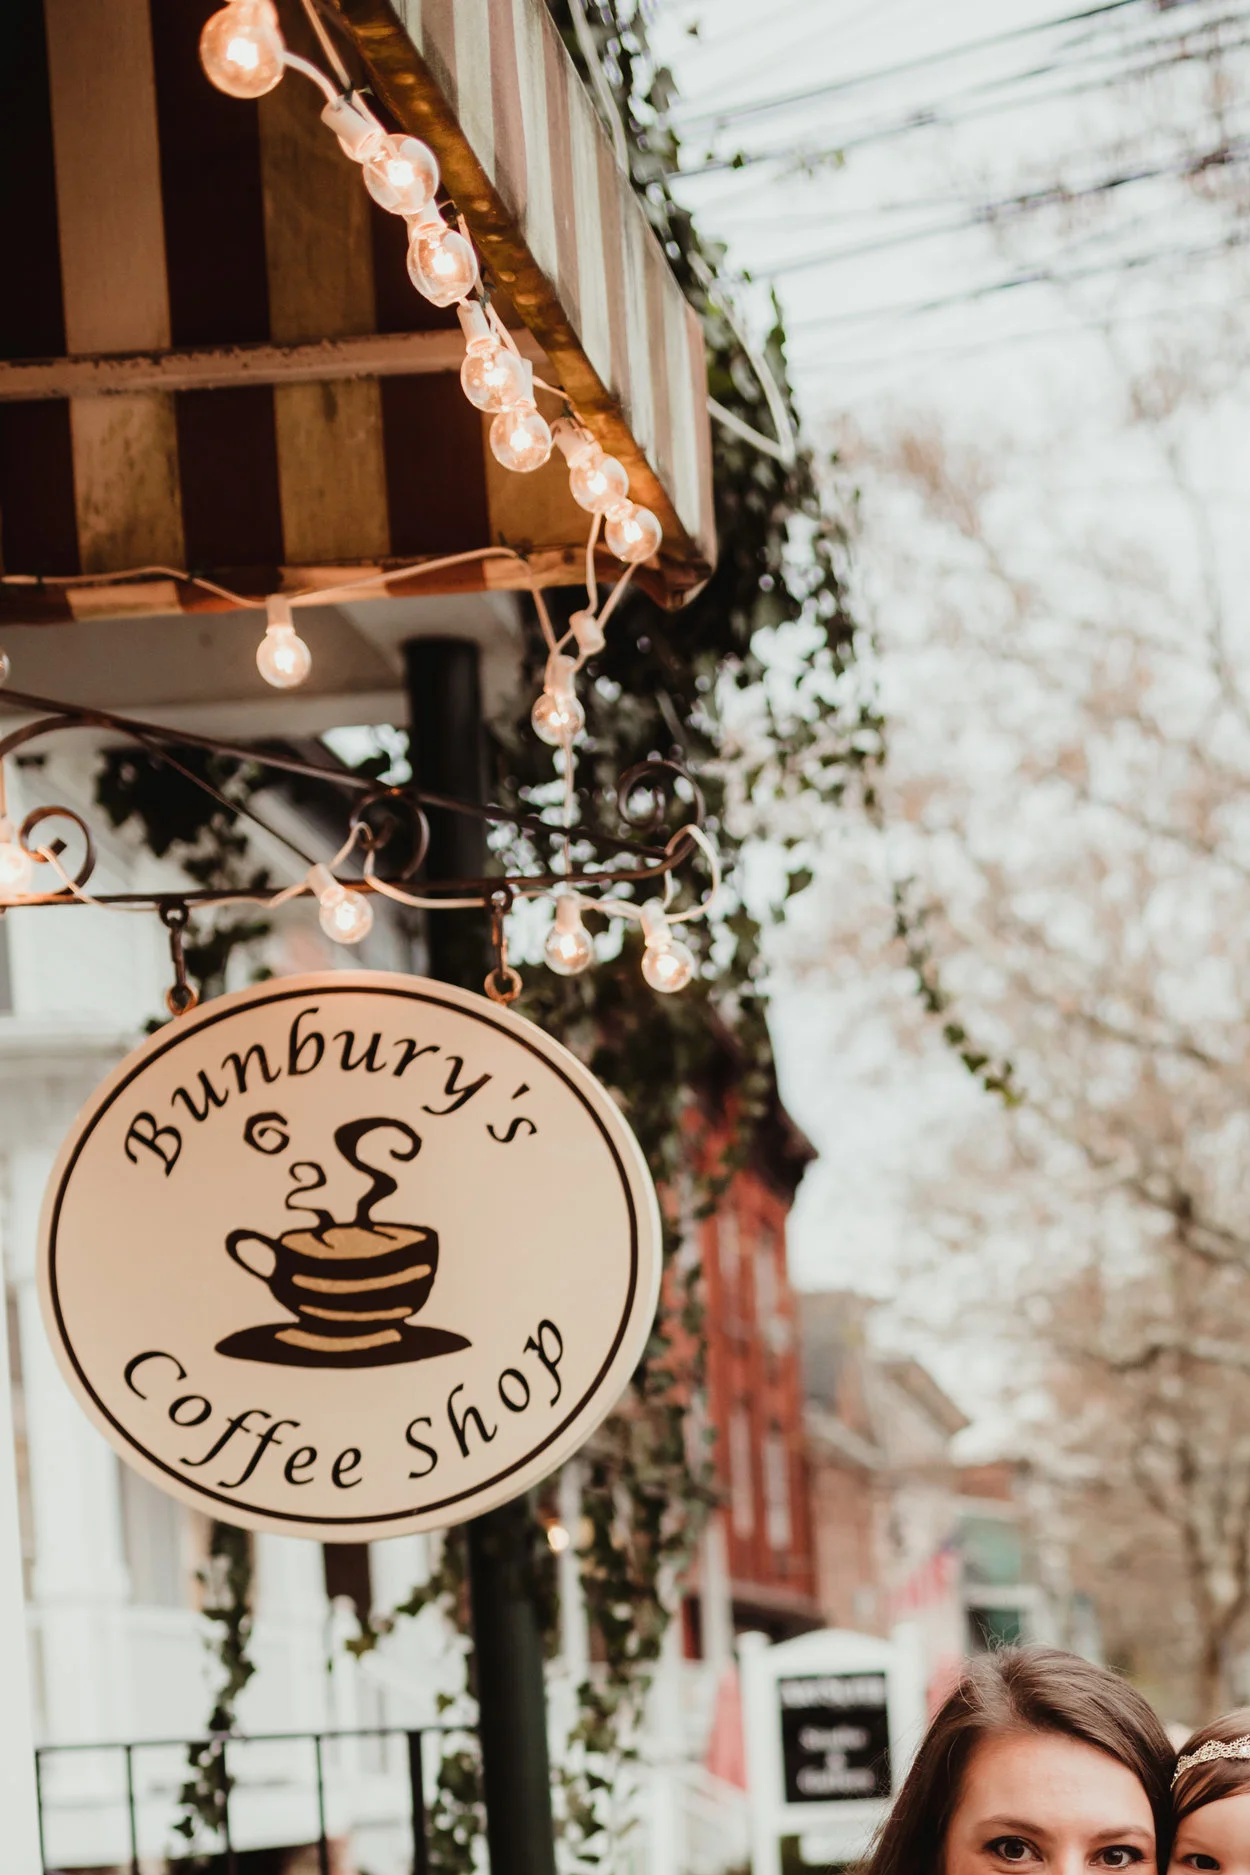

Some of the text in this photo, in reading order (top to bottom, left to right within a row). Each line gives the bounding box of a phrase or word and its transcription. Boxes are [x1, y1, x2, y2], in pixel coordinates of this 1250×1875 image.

[123, 1006, 538, 1178] Bunbury's
[123, 1318, 564, 1489] Coffee Shop
